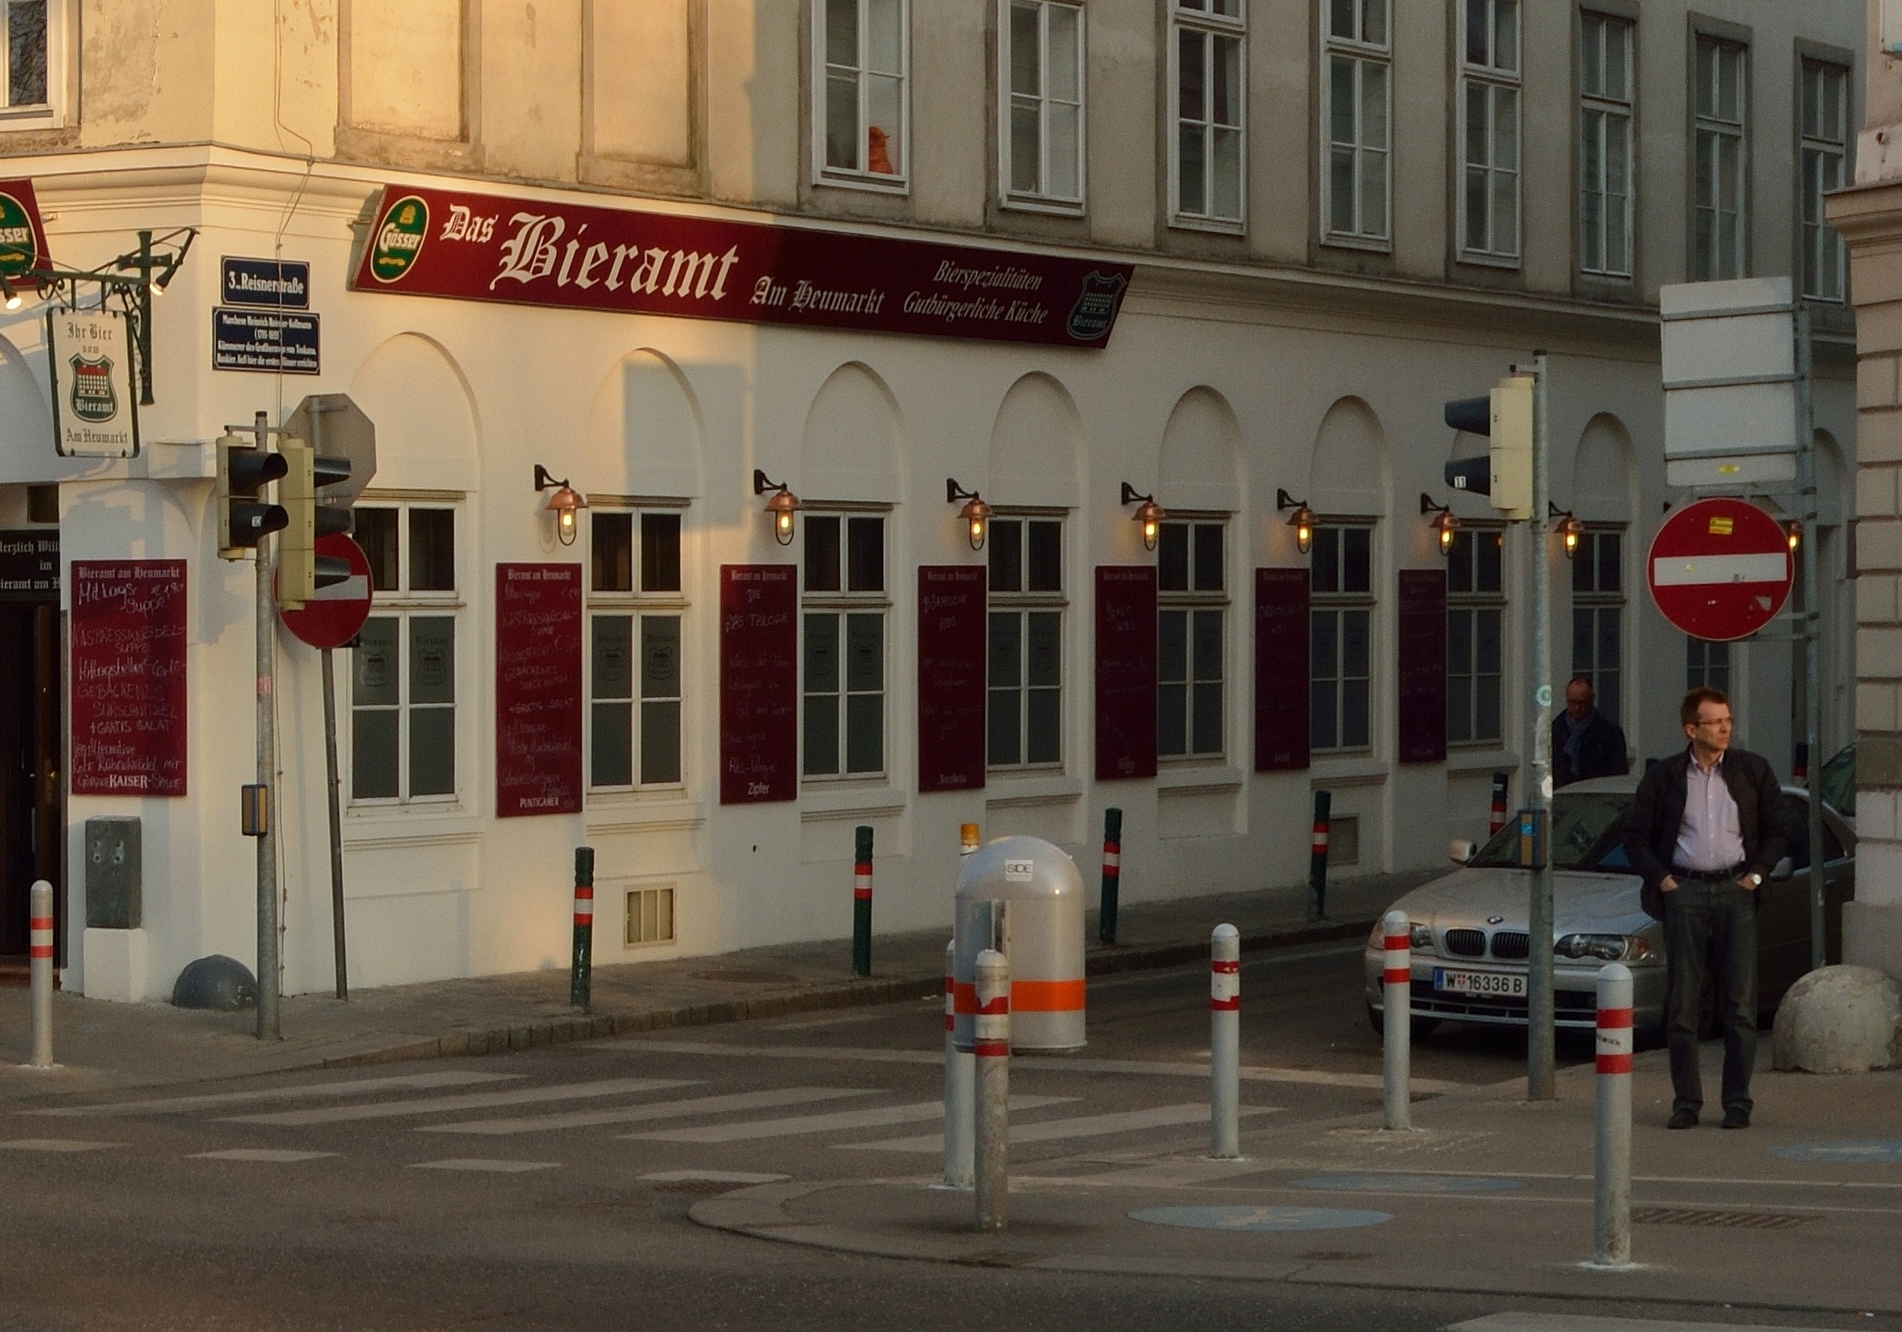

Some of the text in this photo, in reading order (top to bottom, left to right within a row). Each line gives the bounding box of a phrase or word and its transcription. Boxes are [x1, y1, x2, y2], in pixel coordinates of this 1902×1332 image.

[379, 222, 422, 252] Gösser
[440, 204, 740, 301] Das Bieramt
[932, 259, 1044, 291] Bierspezialitäten
[749, 276, 886, 315] Am Heumarkt
[903, 290, 1048, 324] Gutbürgerliche Küche
[67, 322, 113, 342] Ihr Bier
[75, 398, 114, 413] Bieramt
[66, 428, 82, 443] Am
[40, 559, 53, 571] im
[78, 566, 180, 580] Bieramt am Heumarkt
[34, 579, 49, 590] am
[109, 774, 148, 789] KAISER
[1445, 973, 1522, 993] W 16336 B
